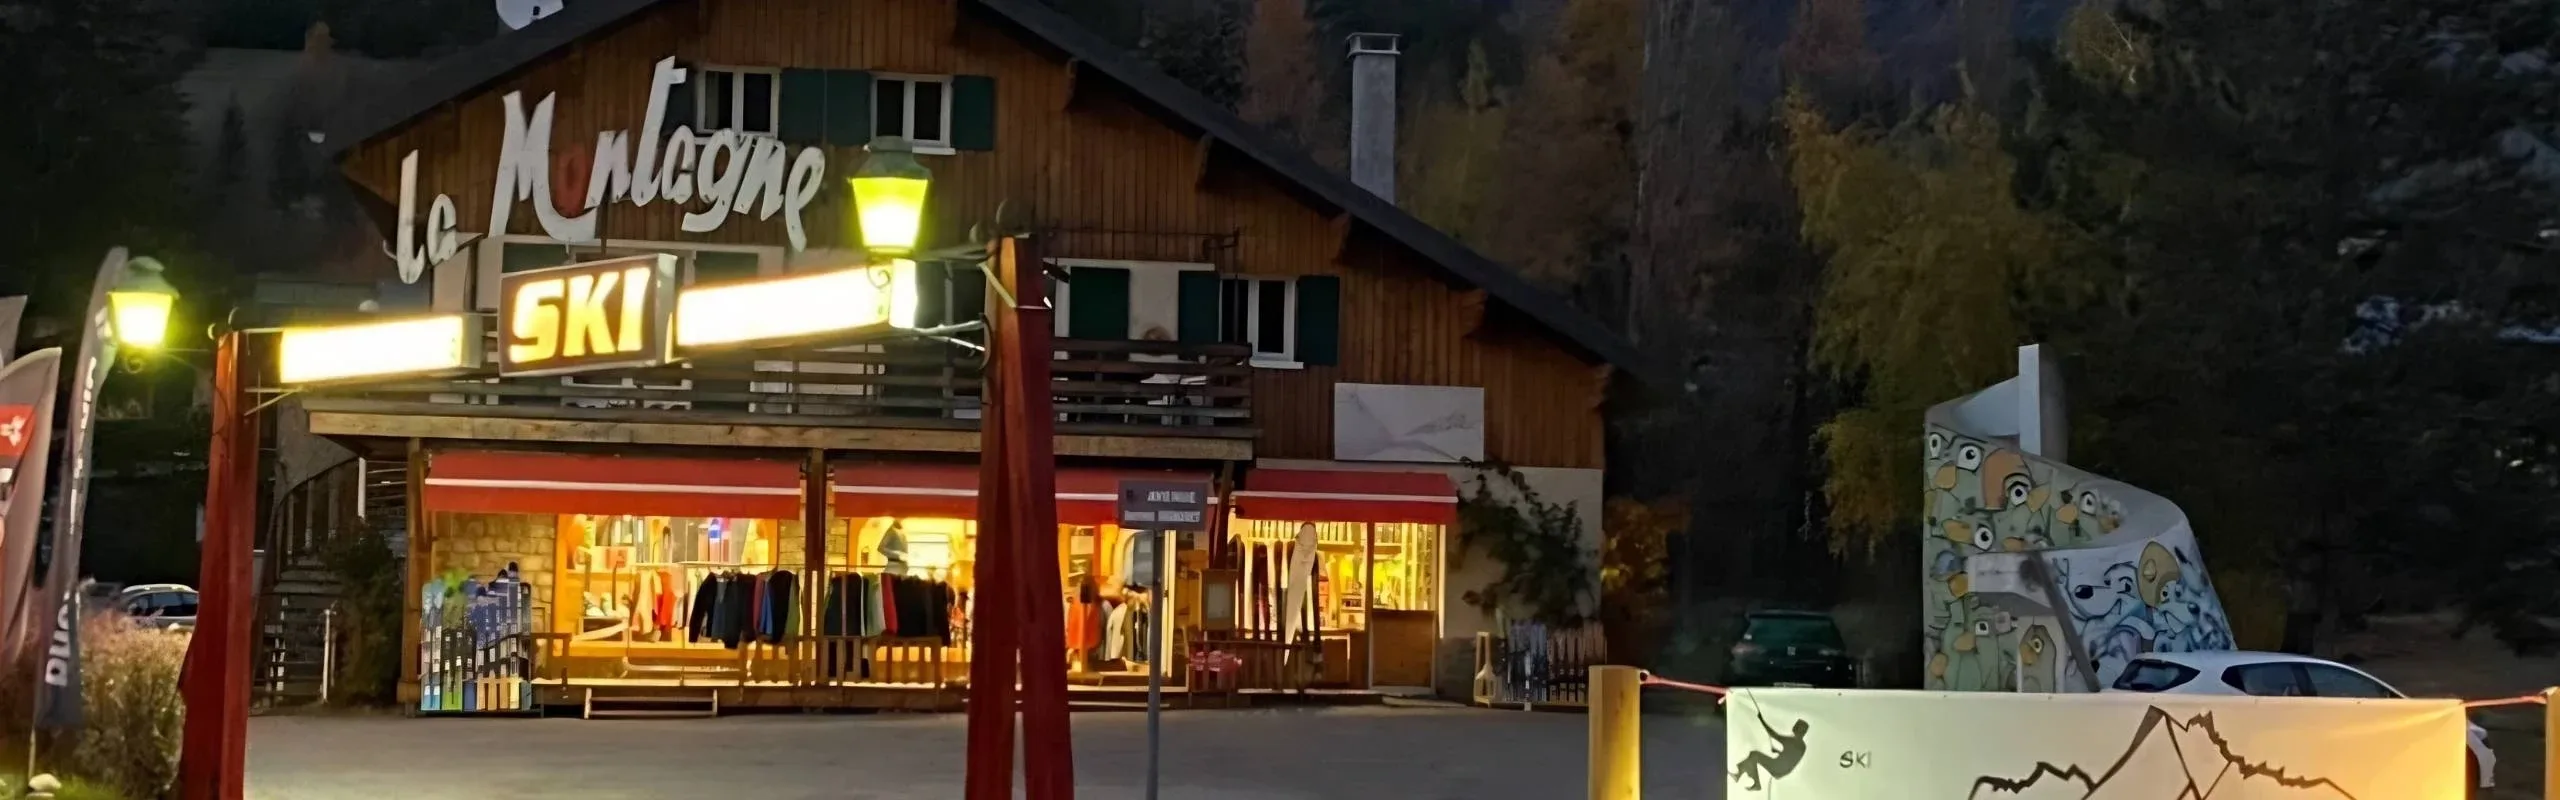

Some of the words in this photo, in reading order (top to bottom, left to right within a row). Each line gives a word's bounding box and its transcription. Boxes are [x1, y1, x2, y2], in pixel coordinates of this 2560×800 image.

[384, 149, 459, 284] La
[488, 55, 825, 252] Montagne
[510, 267, 651, 364] SKI
[1839, 750, 1872, 769] SKI
